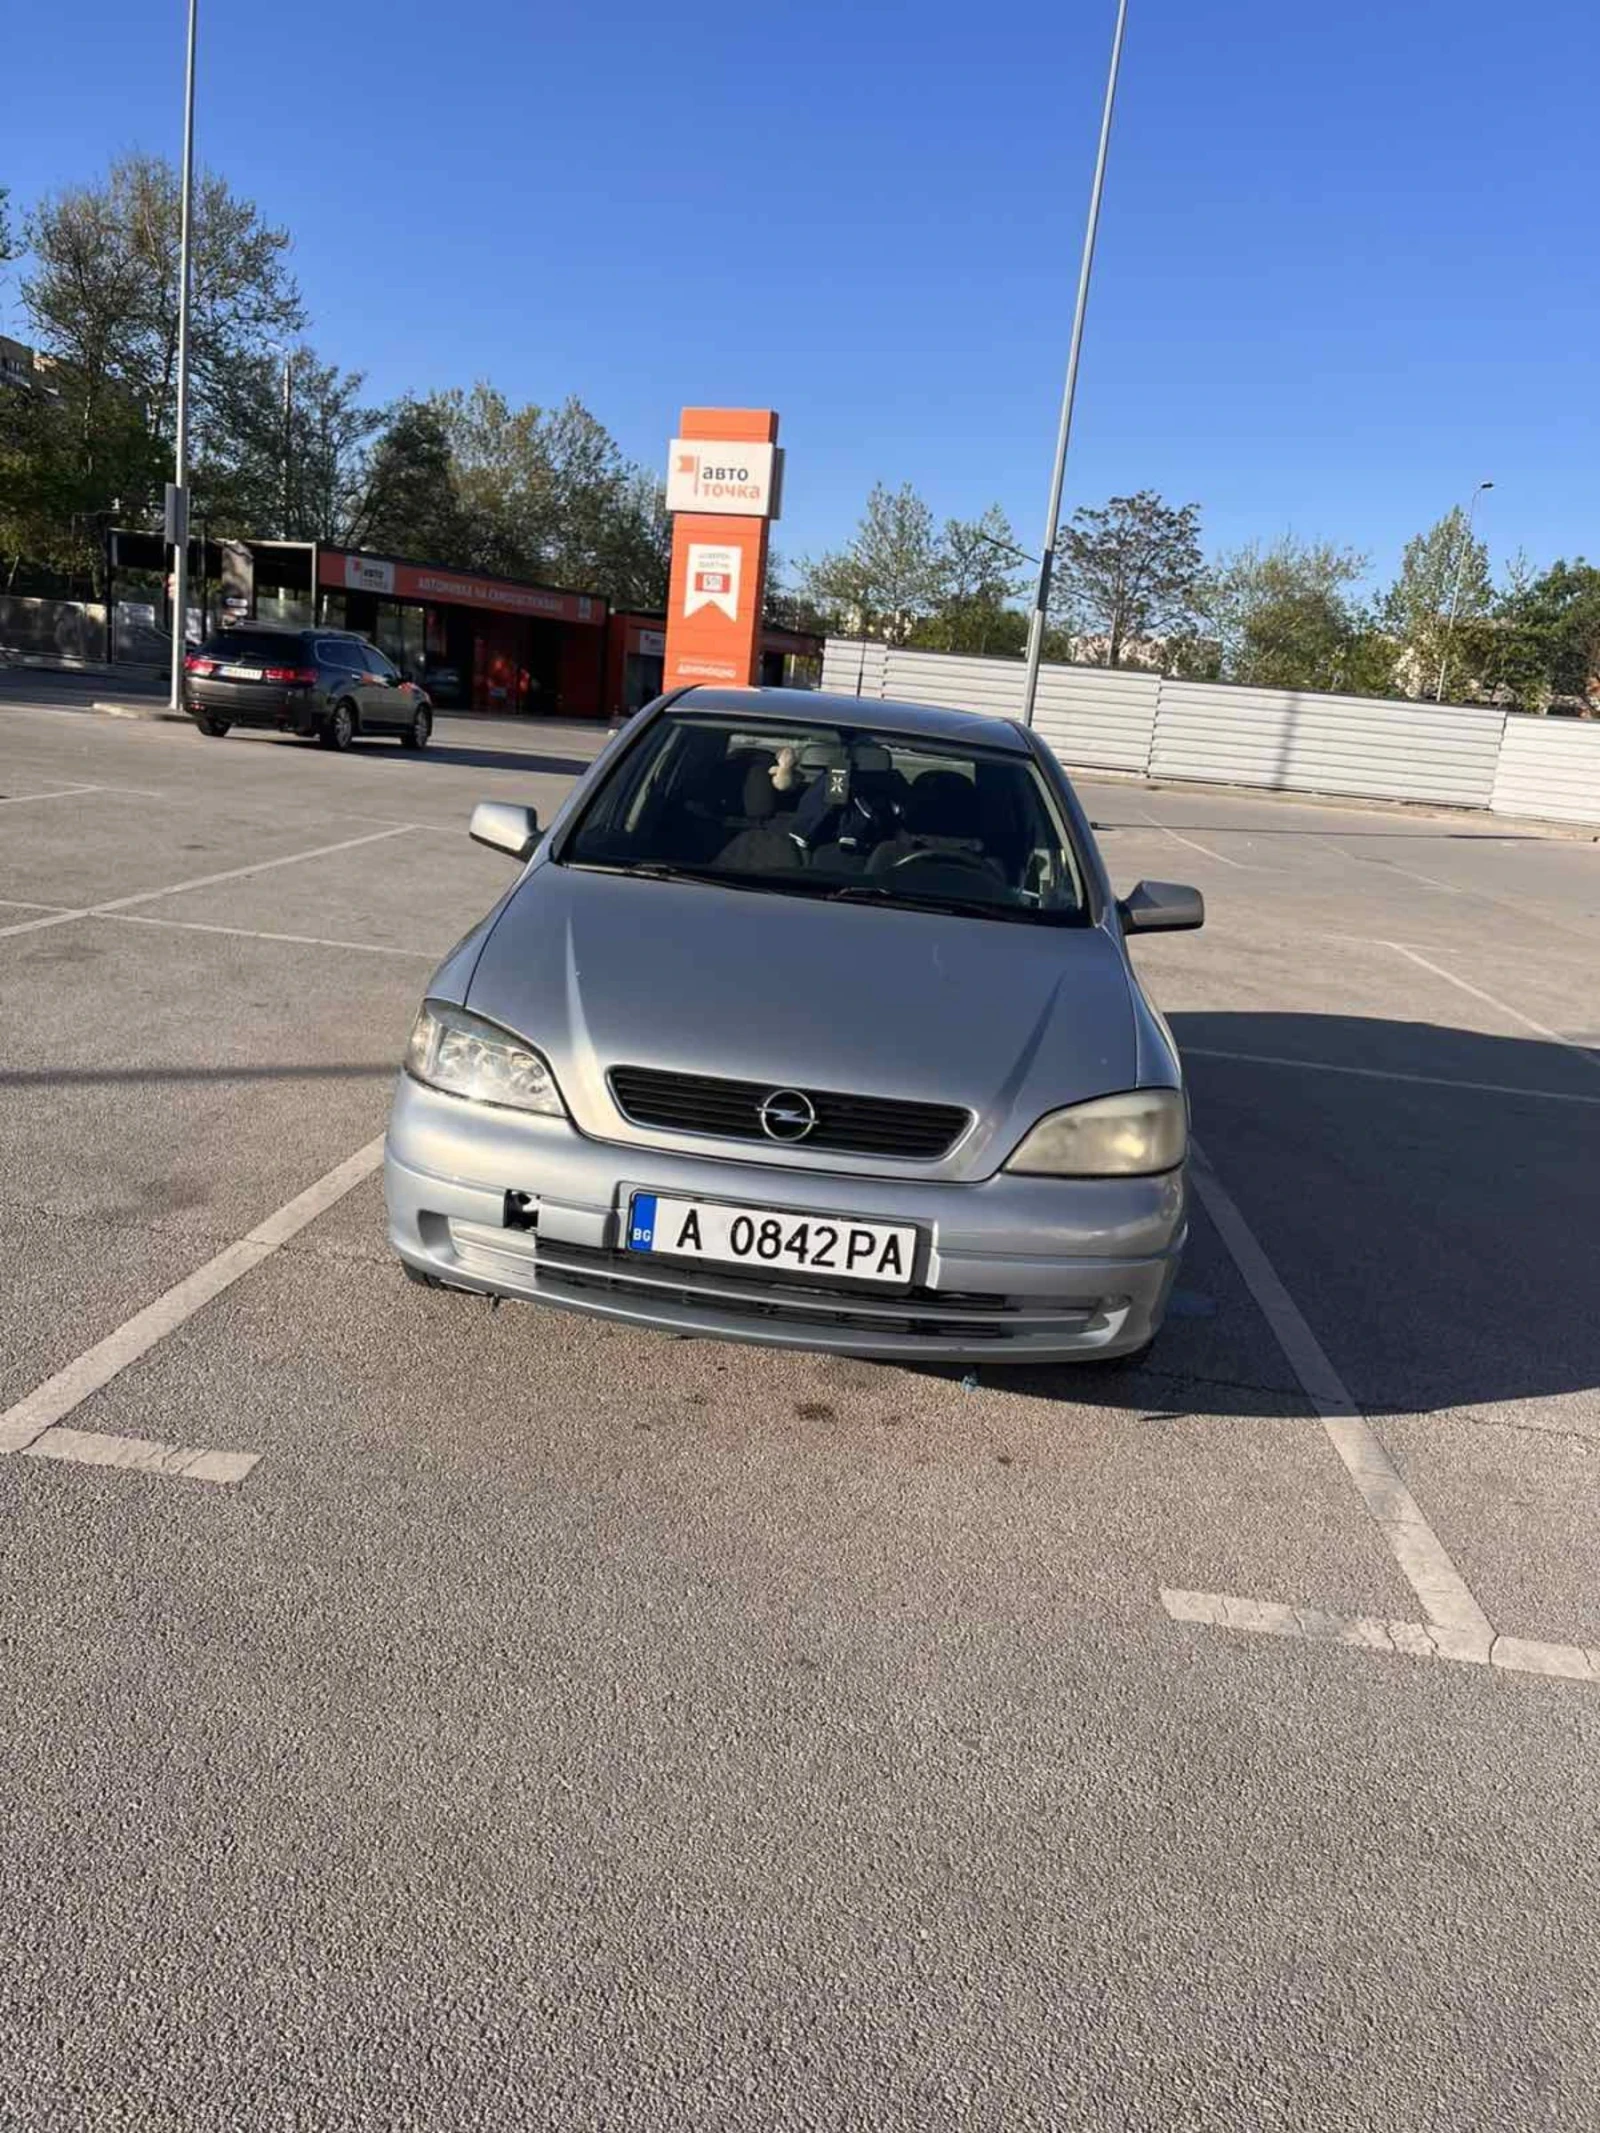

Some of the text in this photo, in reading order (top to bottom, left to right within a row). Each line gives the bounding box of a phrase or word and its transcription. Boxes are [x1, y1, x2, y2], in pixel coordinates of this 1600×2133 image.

[702, 466, 749, 482] авто
[702, 482, 761, 500] точка
[632, 1227, 651, 1243] BG
